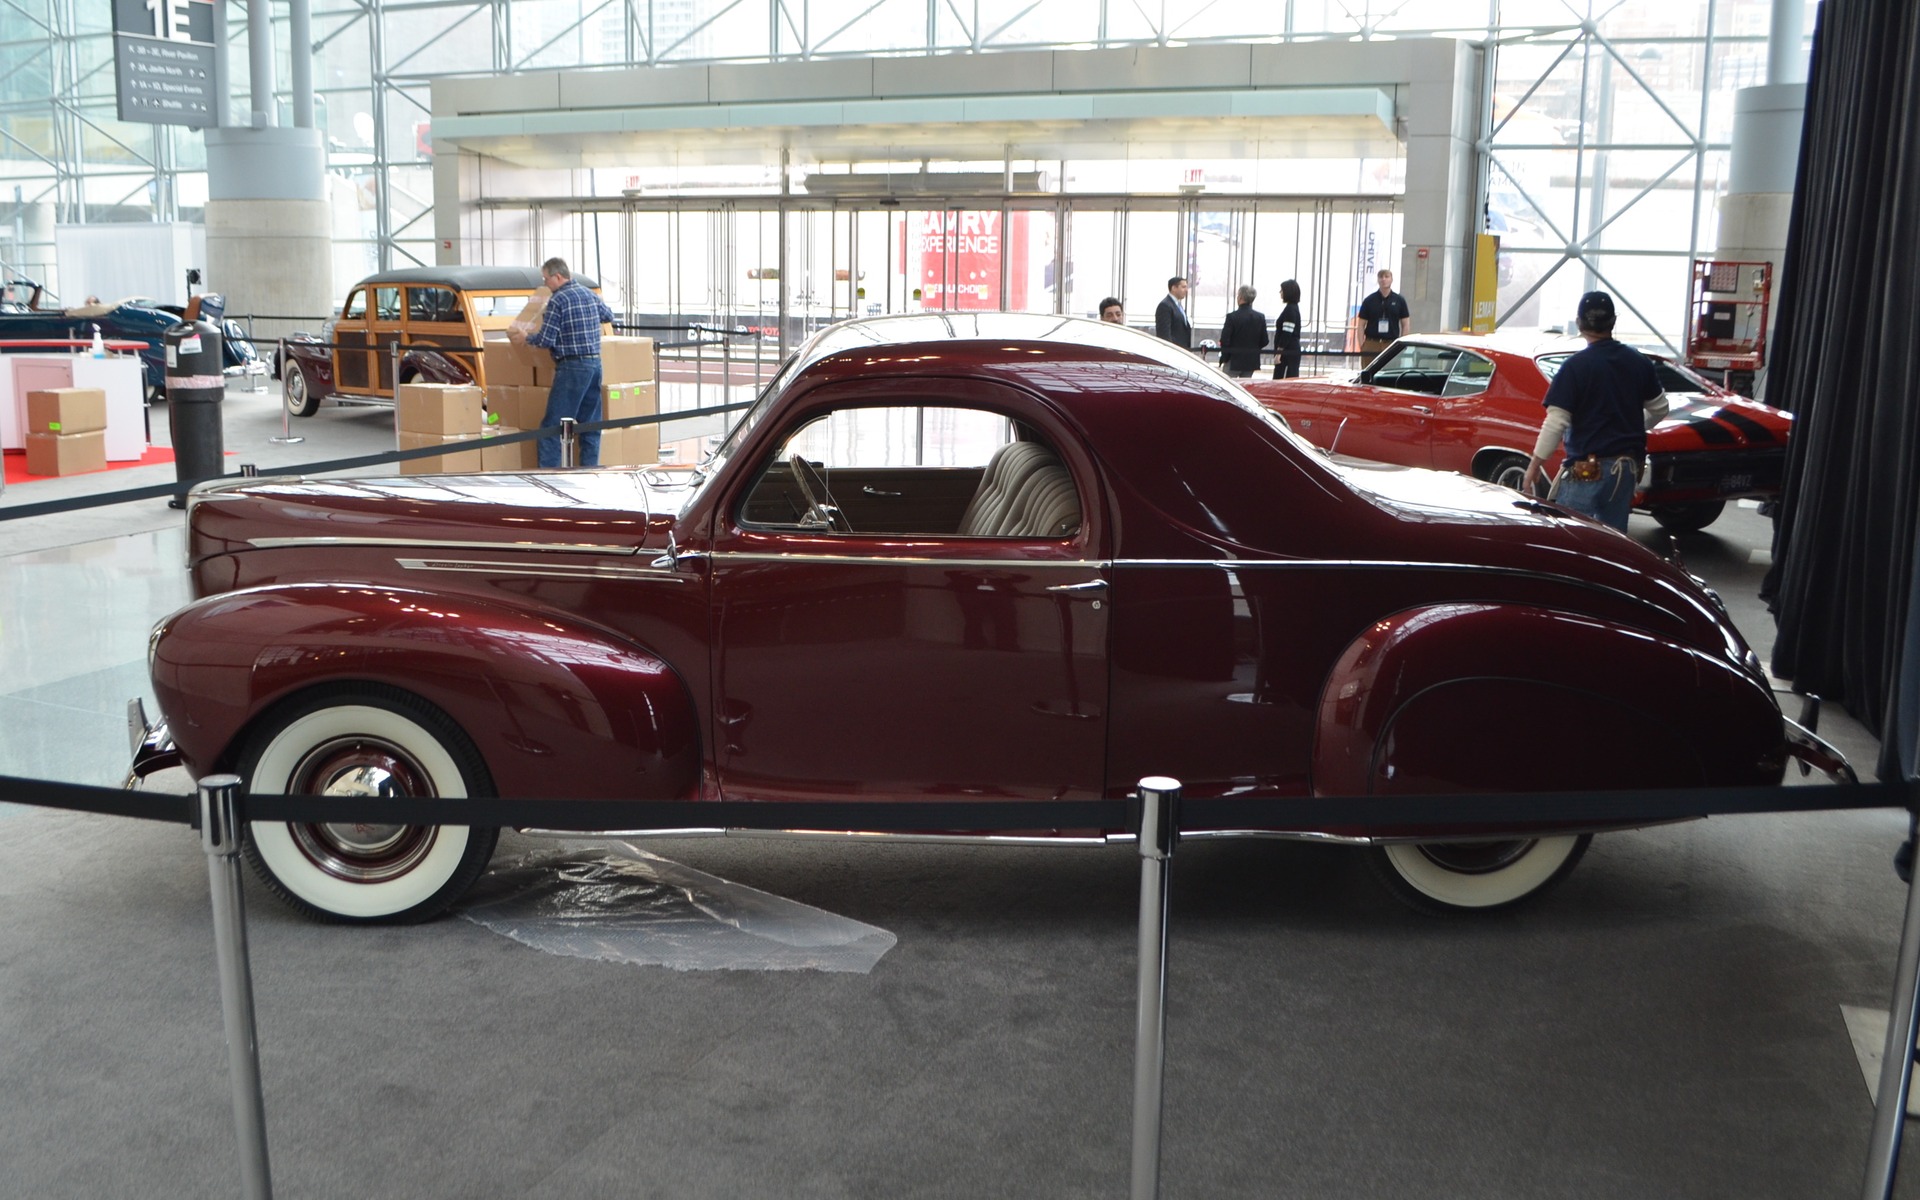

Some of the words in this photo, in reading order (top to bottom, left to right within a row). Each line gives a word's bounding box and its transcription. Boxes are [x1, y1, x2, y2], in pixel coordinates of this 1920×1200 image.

[146, 0, 192, 43] 1E
[166, 66, 183, 76] North
[162, 82, 183, 93] Special
[184, 84, 203, 95] Events
[1184, 169, 1204, 183] EXIT
[920, 211, 998, 235] CAMRY
[920, 236, 998, 254] EXPERIENCE
[1366, 231, 1375, 274] DRIVE
